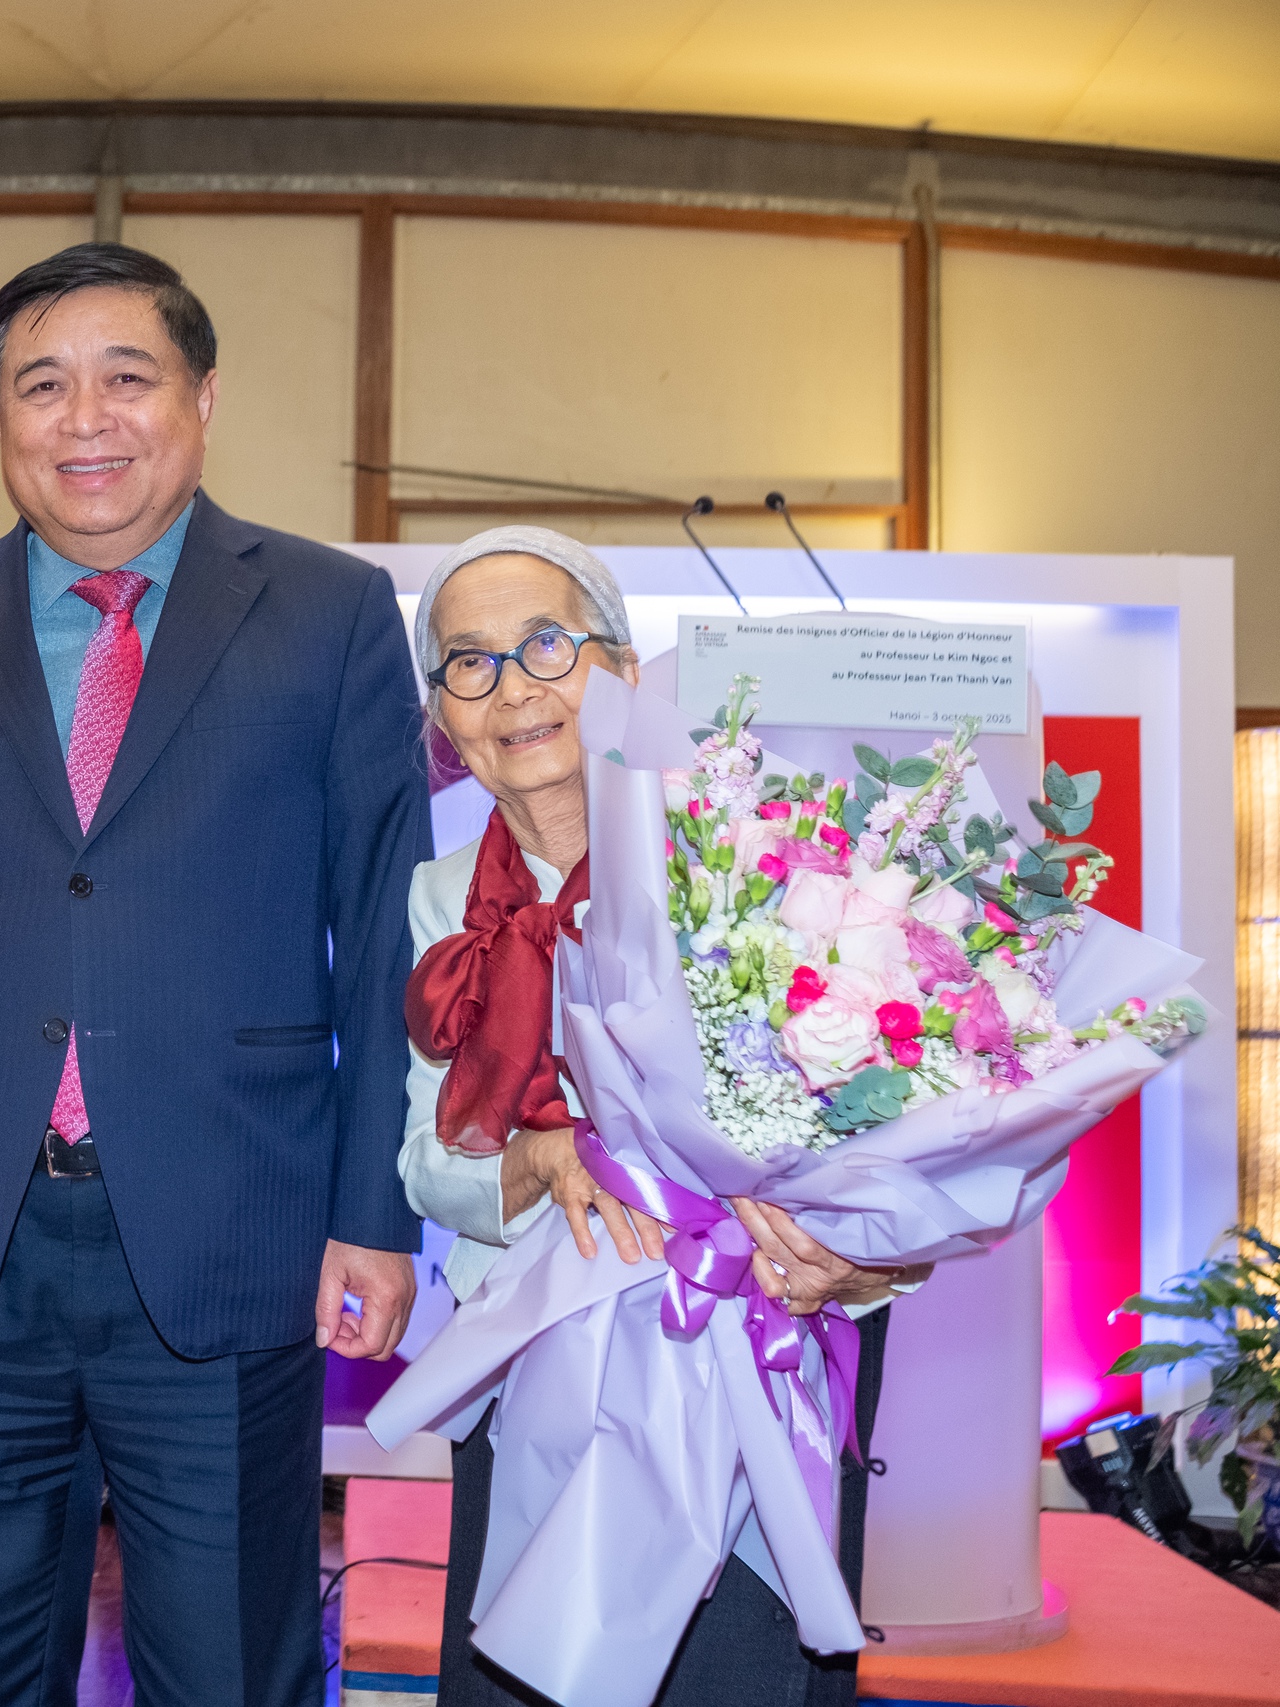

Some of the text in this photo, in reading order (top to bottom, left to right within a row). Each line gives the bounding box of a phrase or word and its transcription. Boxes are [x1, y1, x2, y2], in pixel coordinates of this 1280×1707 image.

[737, 624, 774, 635] Remise
[775, 625, 794, 635] des
[796, 626, 838, 639] insignes
[892, 629, 906, 639] de
[908, 629, 917, 639] la
[920, 630, 955, 643] Légion
[860, 650, 1013, 666] au Professeur Le Kim Ngoc et
[831, 670, 1012, 685] au Professeur Jean Tran Thanh Van
[889, 710, 921, 721] Hanoi
[932, 711, 939, 722] 3
[986, 713, 1012, 724] 2025
